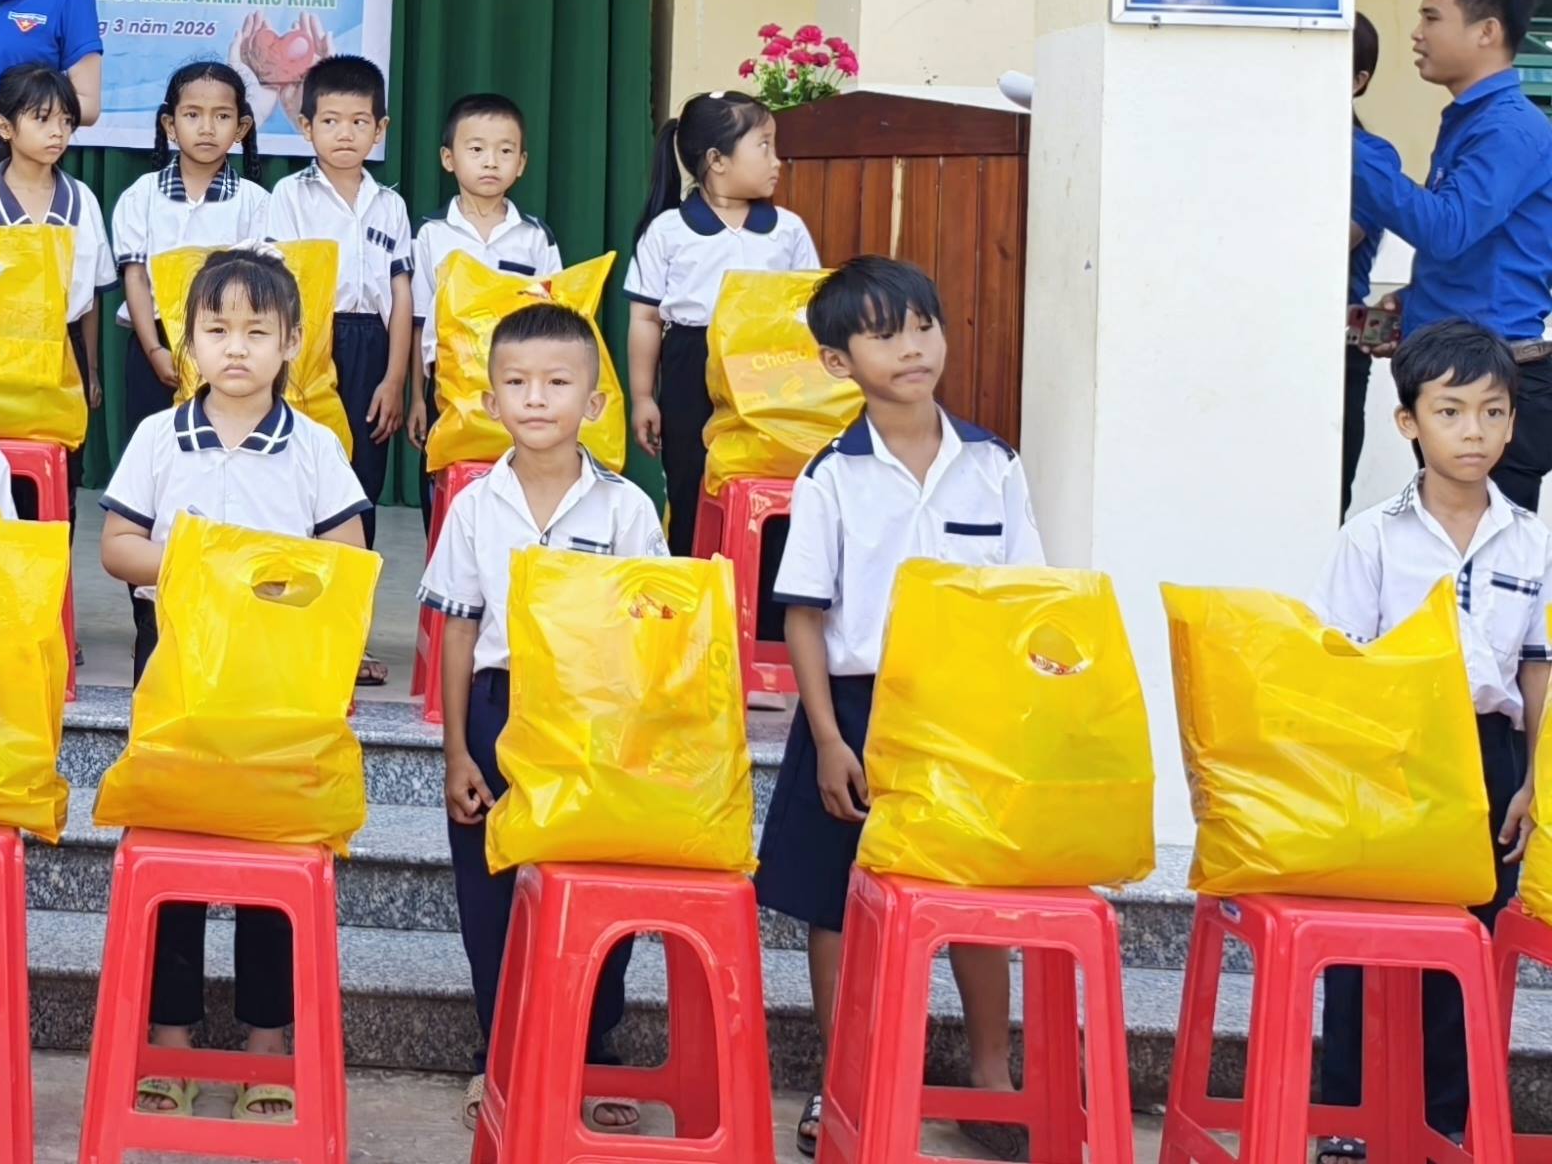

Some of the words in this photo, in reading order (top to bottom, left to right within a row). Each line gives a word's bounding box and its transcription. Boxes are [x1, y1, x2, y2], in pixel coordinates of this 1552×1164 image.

[113, 19, 124, 33] 3
[129, 19, 167, 34] năm
[173, 21, 216, 35] 2026
